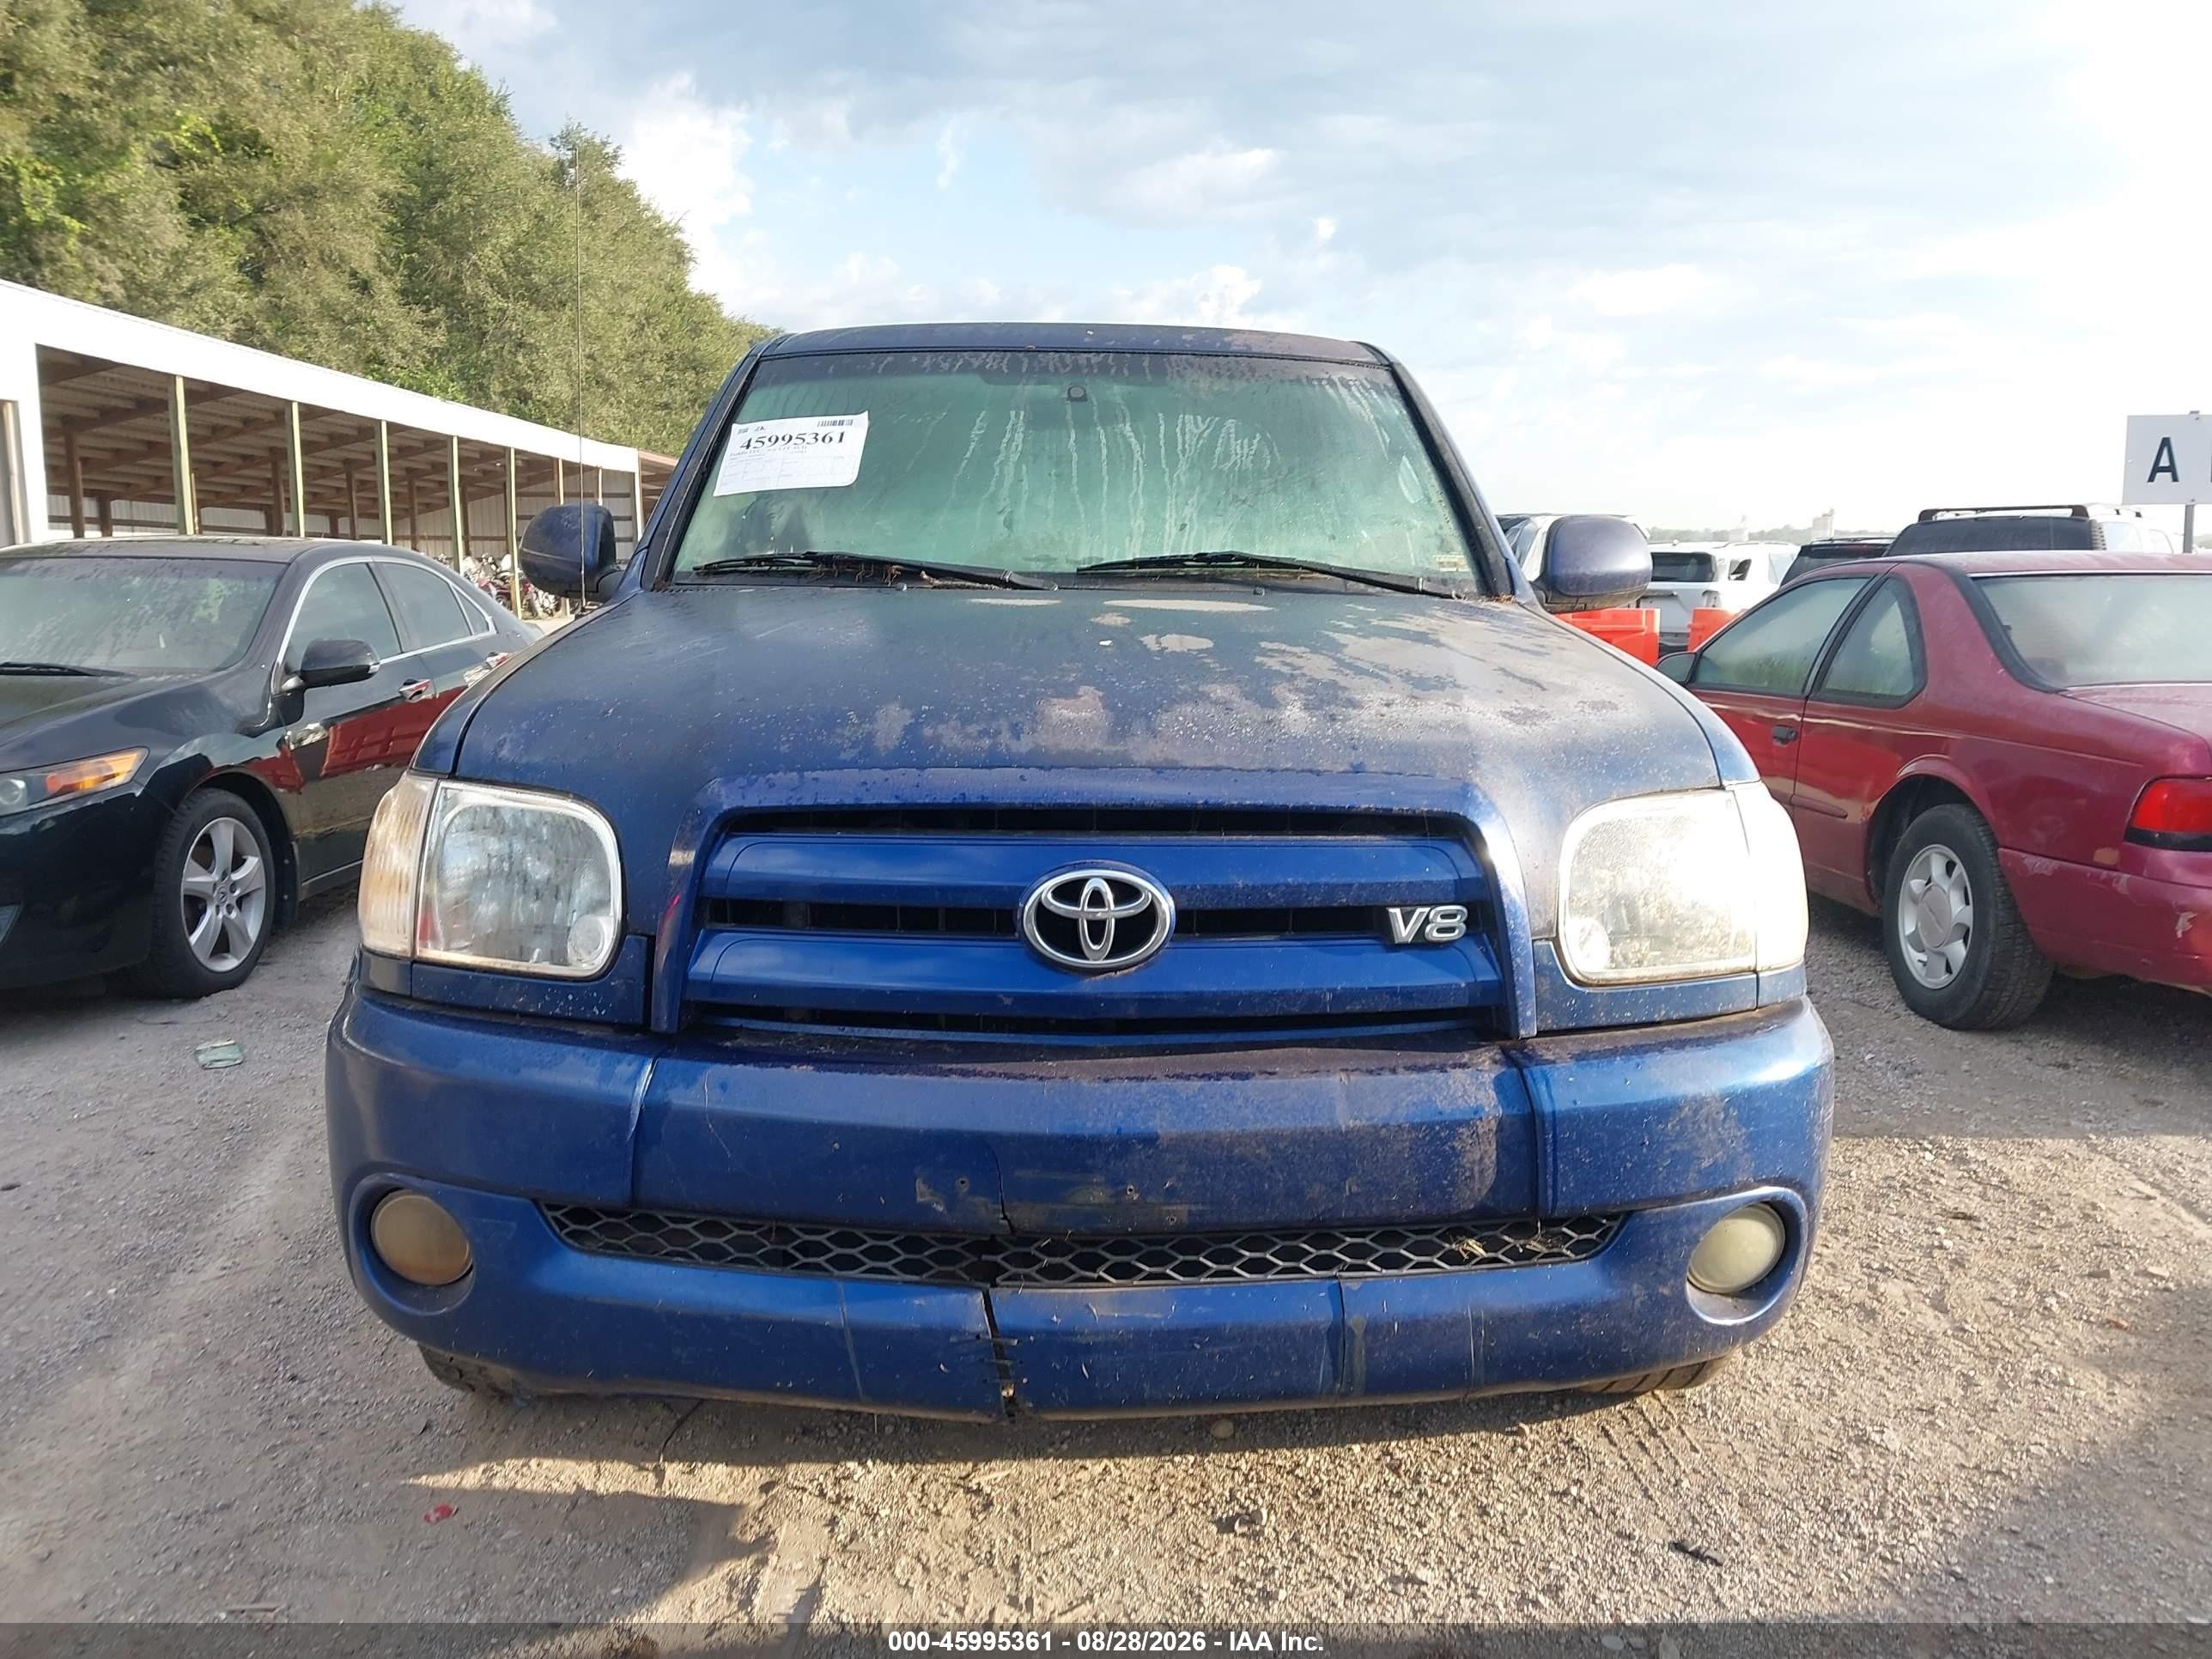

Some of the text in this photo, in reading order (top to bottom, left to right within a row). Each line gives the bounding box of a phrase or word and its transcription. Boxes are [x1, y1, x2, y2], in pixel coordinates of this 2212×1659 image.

[739, 430, 846, 450] 45995361
[2147, 436, 2180, 483] A
[1386, 904, 1468, 945] V8
